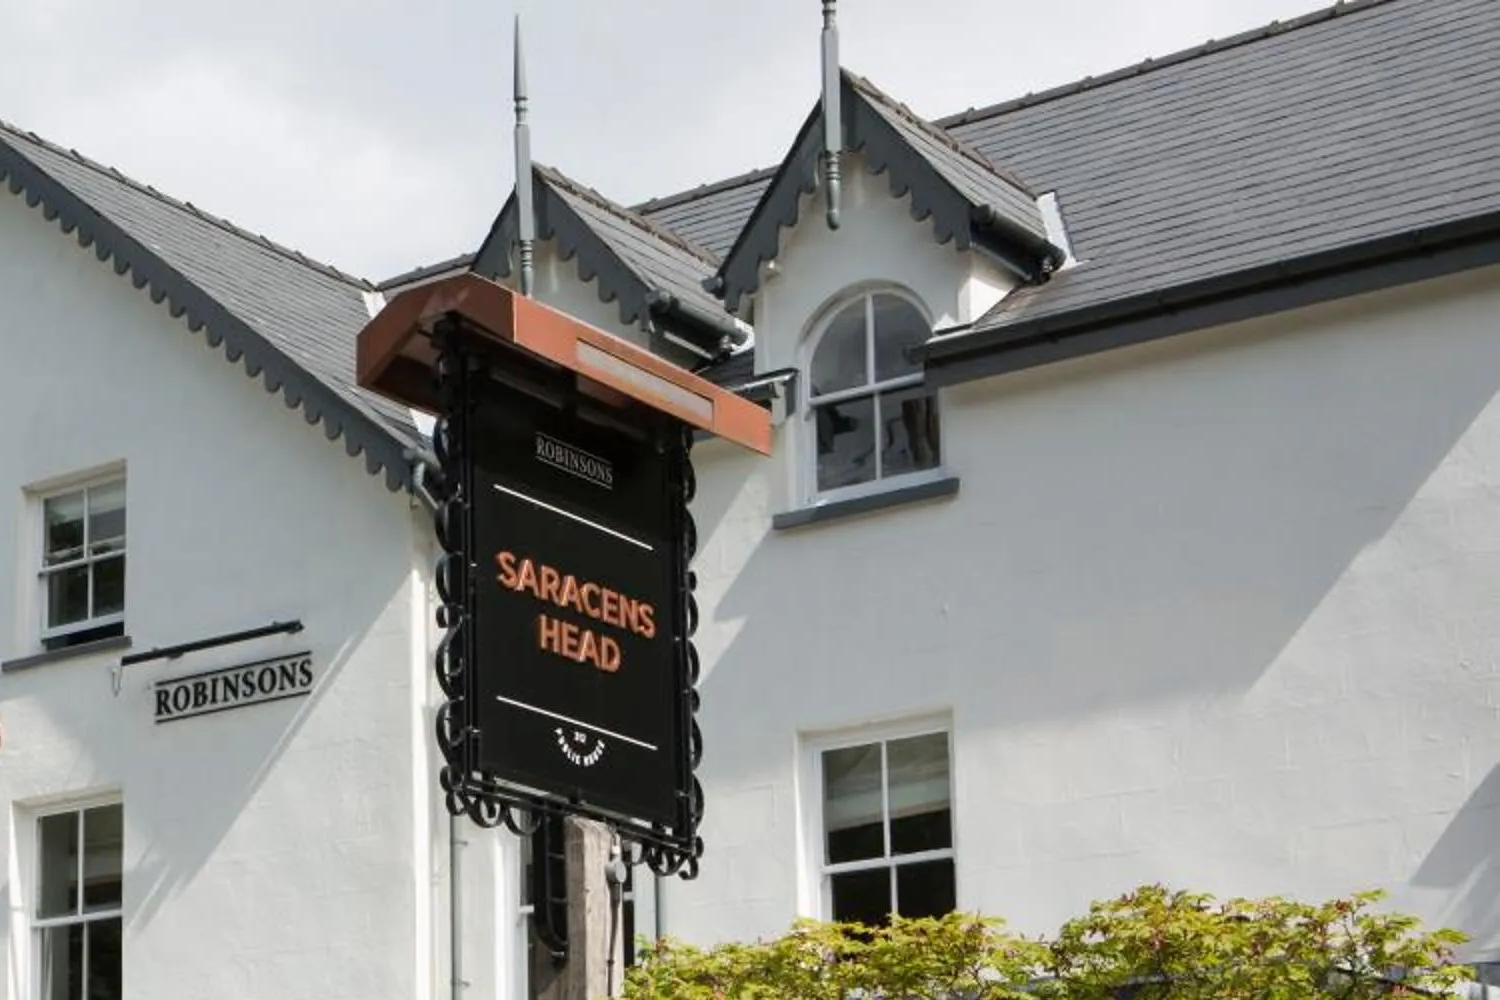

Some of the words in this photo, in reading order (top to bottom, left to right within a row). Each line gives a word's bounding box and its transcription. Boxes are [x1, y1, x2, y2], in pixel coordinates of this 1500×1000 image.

[536, 435, 613, 484] ROBINSONS
[496, 551, 656, 639] SARACENS
[539, 615, 621, 673] HEAD
[154, 658, 313, 717] ROBINSONS
